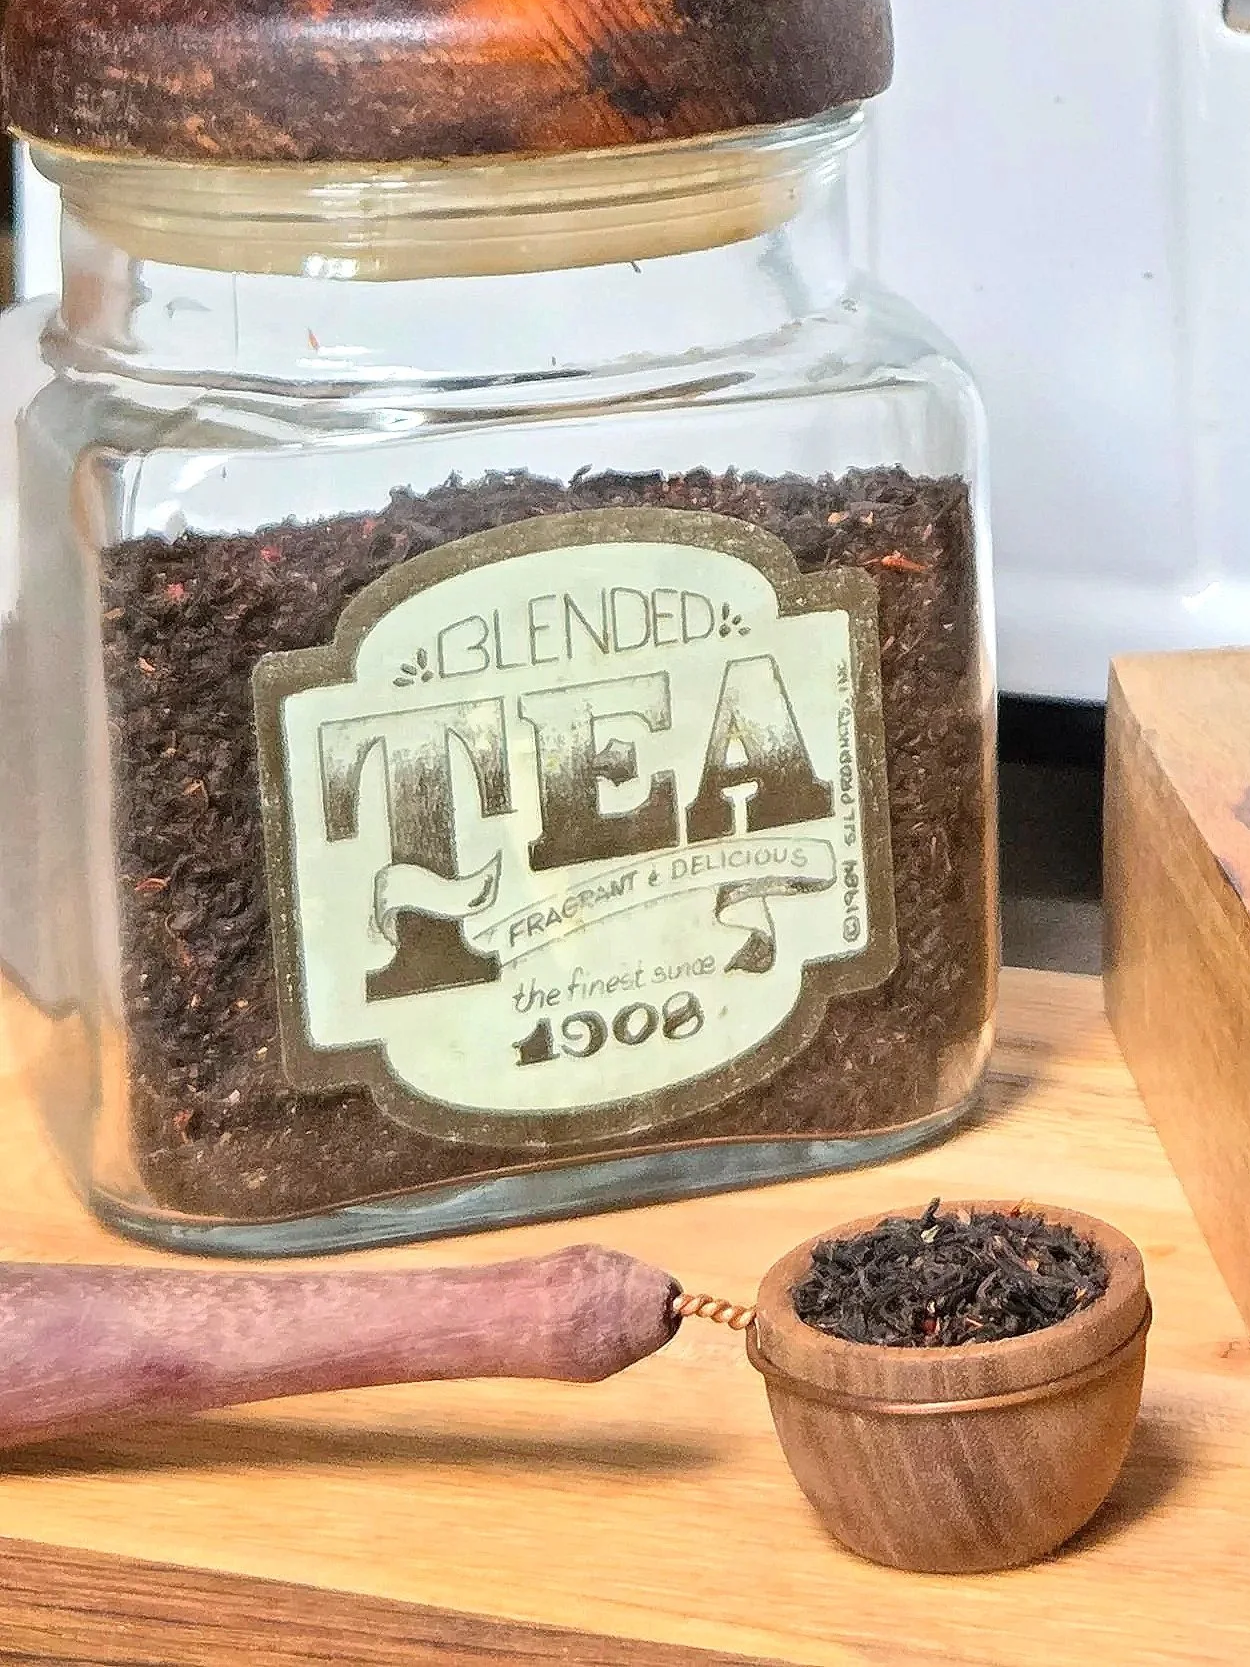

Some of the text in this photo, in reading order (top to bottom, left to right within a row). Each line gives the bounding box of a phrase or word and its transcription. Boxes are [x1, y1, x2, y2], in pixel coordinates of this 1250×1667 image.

[437, 586, 717, 680] BLENDED
[318, 654, 836, 1002] TEA
[507, 869, 638, 947] FRAGRANT
[671, 848, 809, 881] DELICIOUS
[512, 978, 561, 1014] the
[568, 961, 645, 1000] finest
[512, 991, 705, 1067] 1908
